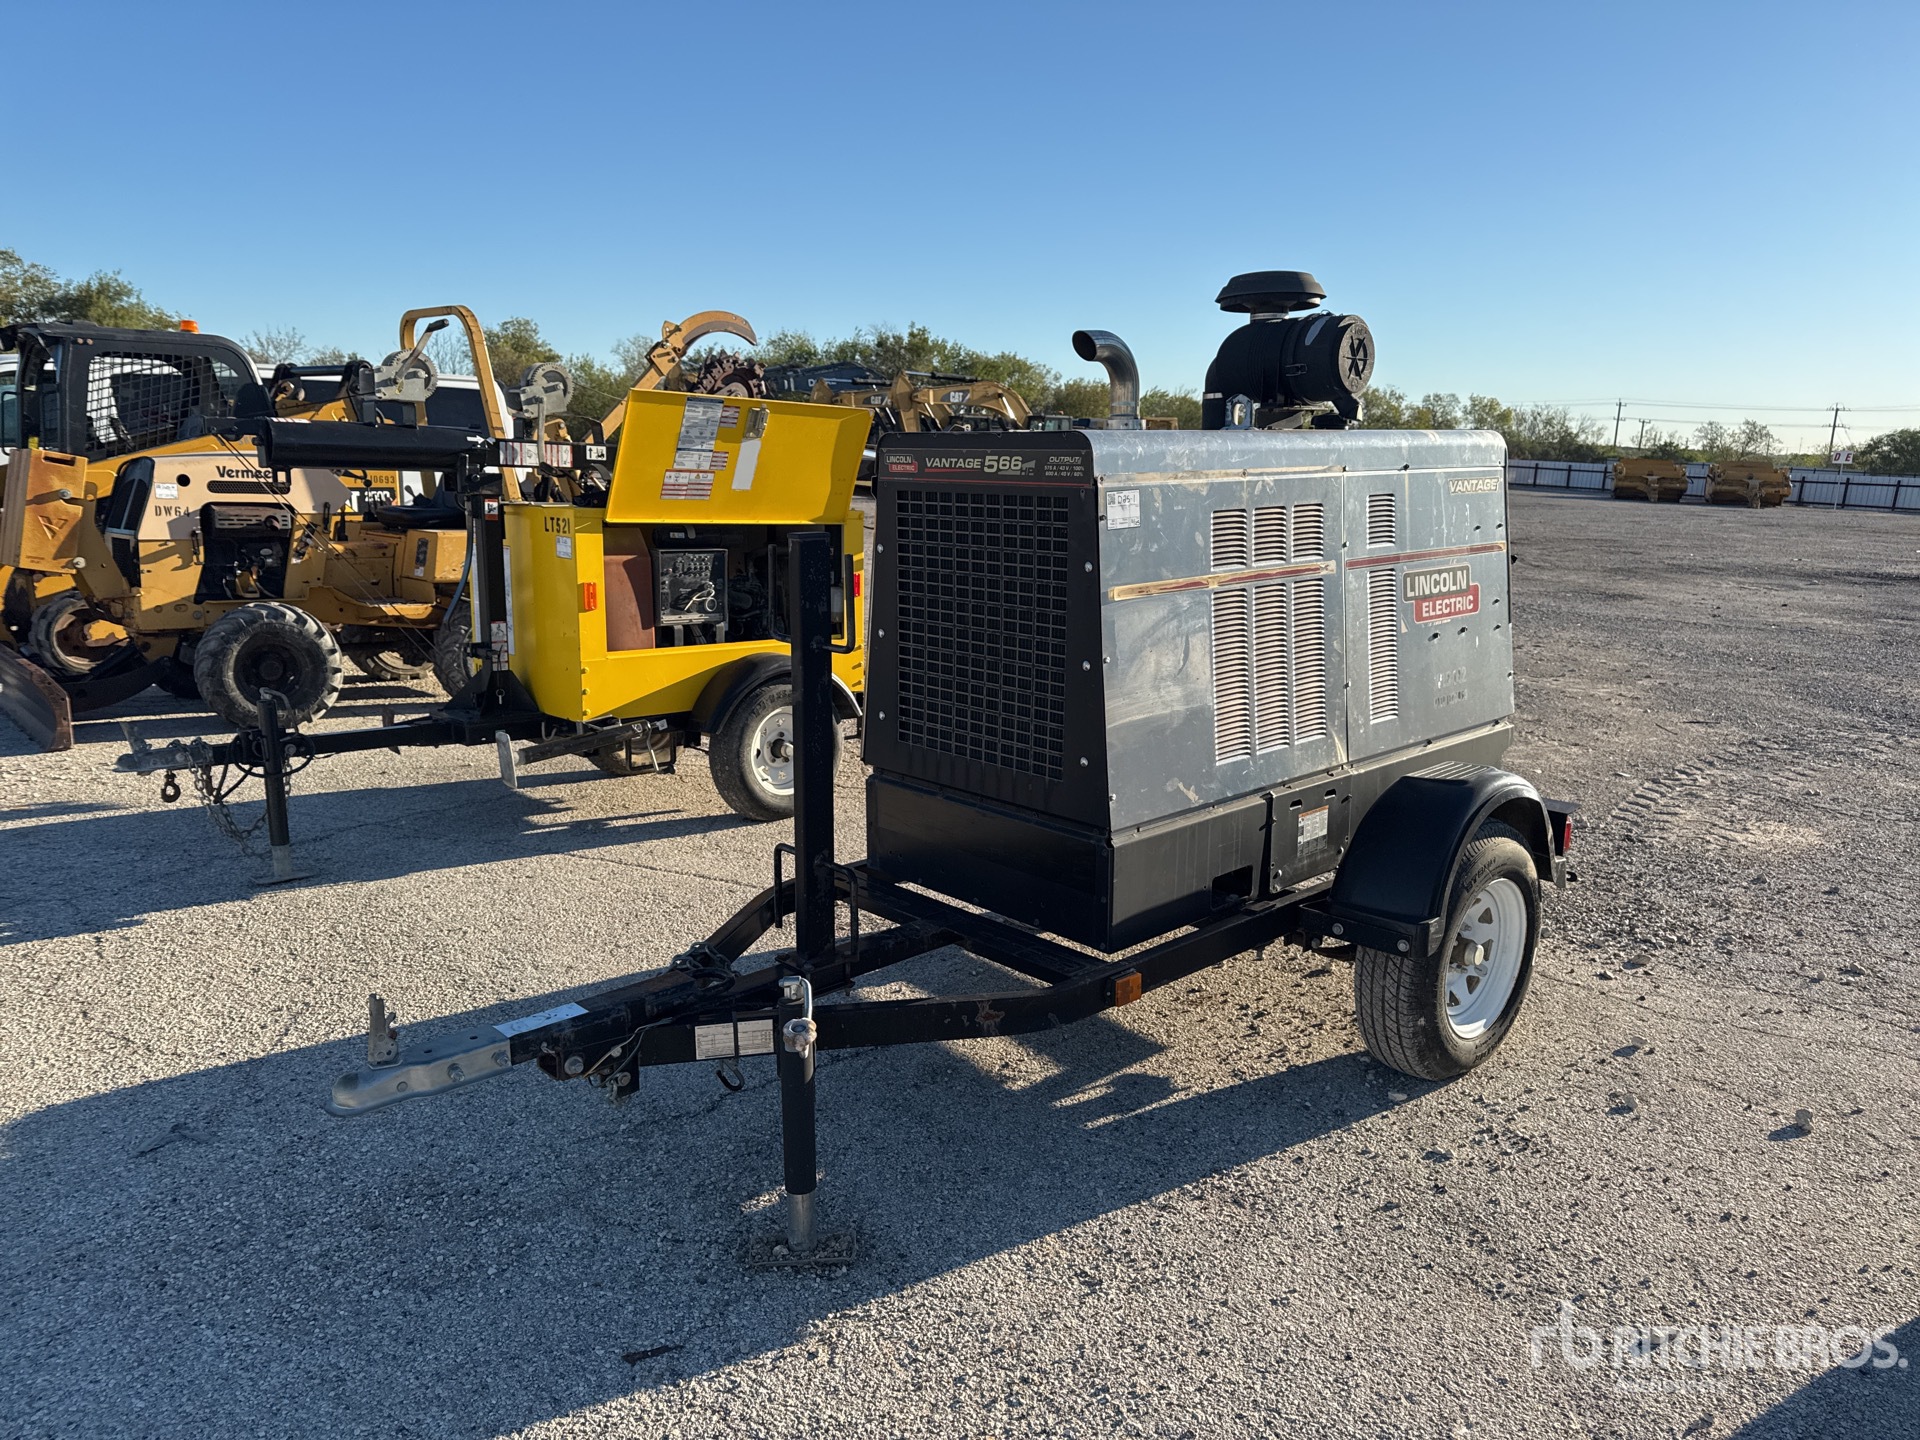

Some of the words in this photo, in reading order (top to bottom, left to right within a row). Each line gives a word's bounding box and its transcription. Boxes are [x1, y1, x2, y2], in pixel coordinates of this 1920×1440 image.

[870, 395, 882, 404] CAT
[950, 392, 963, 402] CAT
[886, 455, 911, 463] LINCOLN
[1833, 452, 1841, 461] D
[1845, 452, 1852, 461] E
[925, 457, 981, 468] VANTAGE
[983, 455, 1022, 473] 566
[216, 465, 272, 478] Vermee
[1449, 479, 1498, 492] VANTAGE
[154, 505, 190, 517] DW64
[544, 516, 571, 534] LT521
[1406, 569, 1467, 597] LINCOLN
[1422, 595, 1474, 617] ELECTRIC
